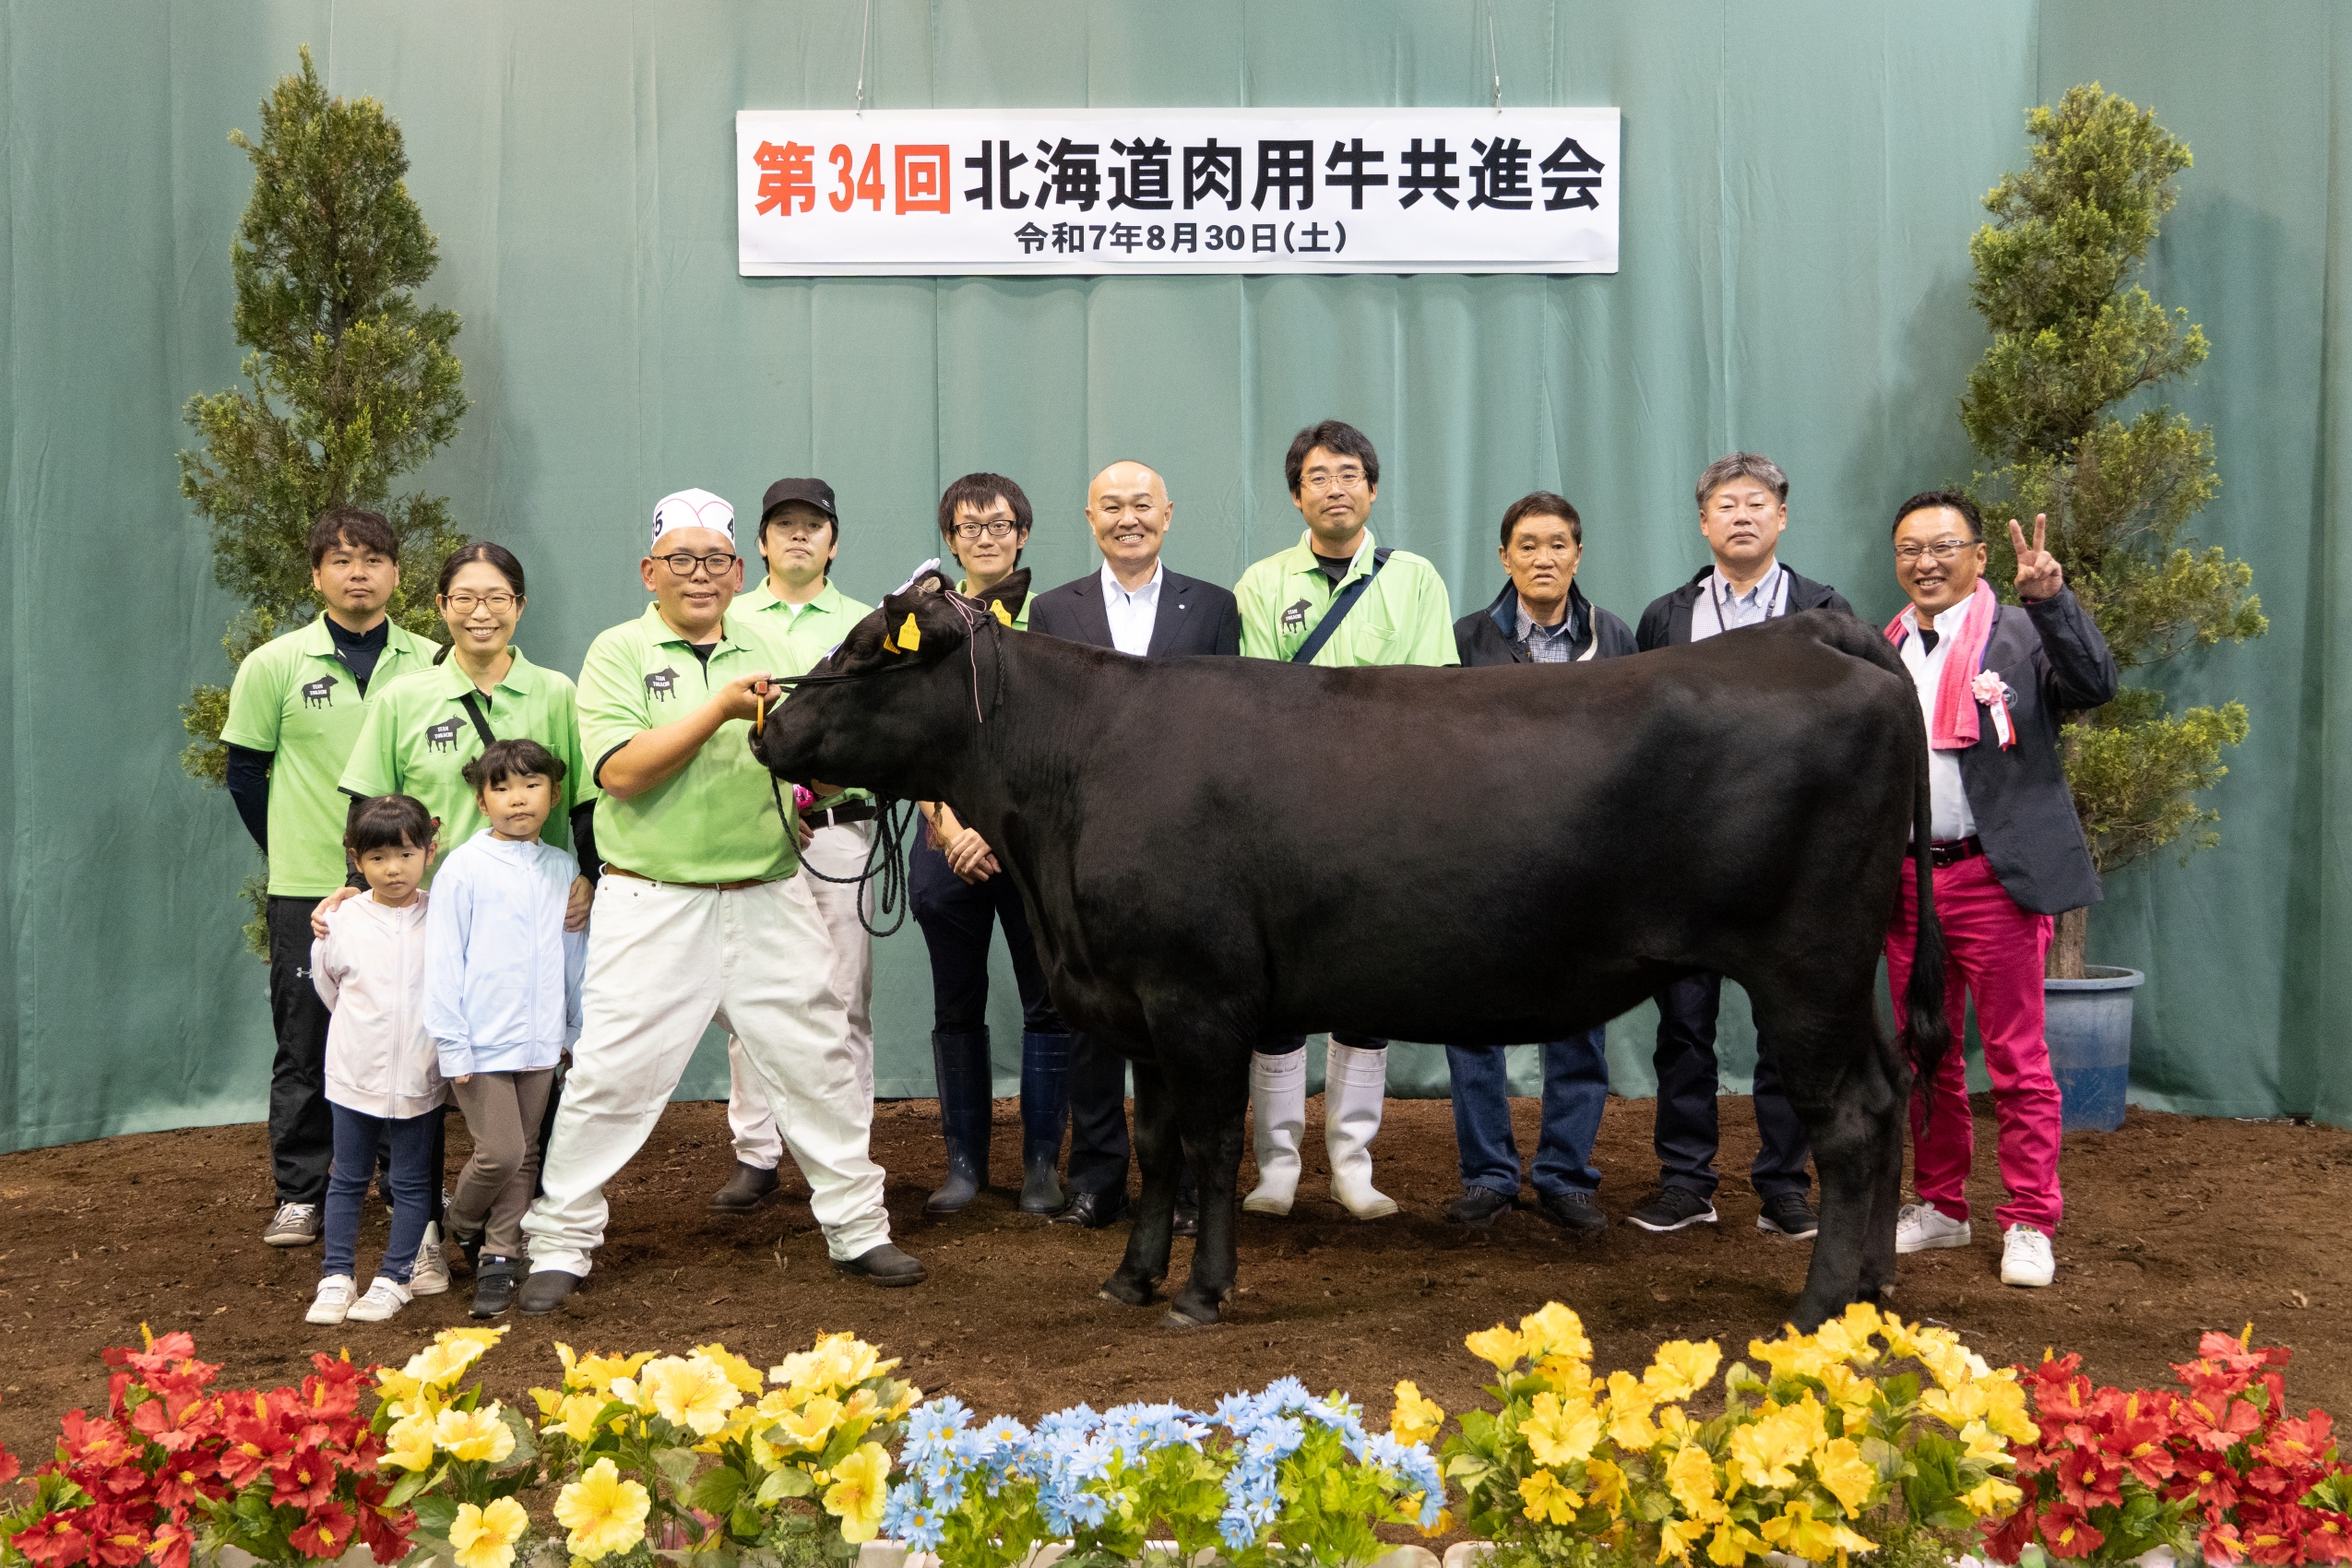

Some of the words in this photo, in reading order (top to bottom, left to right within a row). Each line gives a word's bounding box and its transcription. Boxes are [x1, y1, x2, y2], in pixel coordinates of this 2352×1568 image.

[754, 136, 1606, 216] 第34回北海道肉用牛共進会
[1014, 220, 1347, 255] 令和7年8月30日(土)
